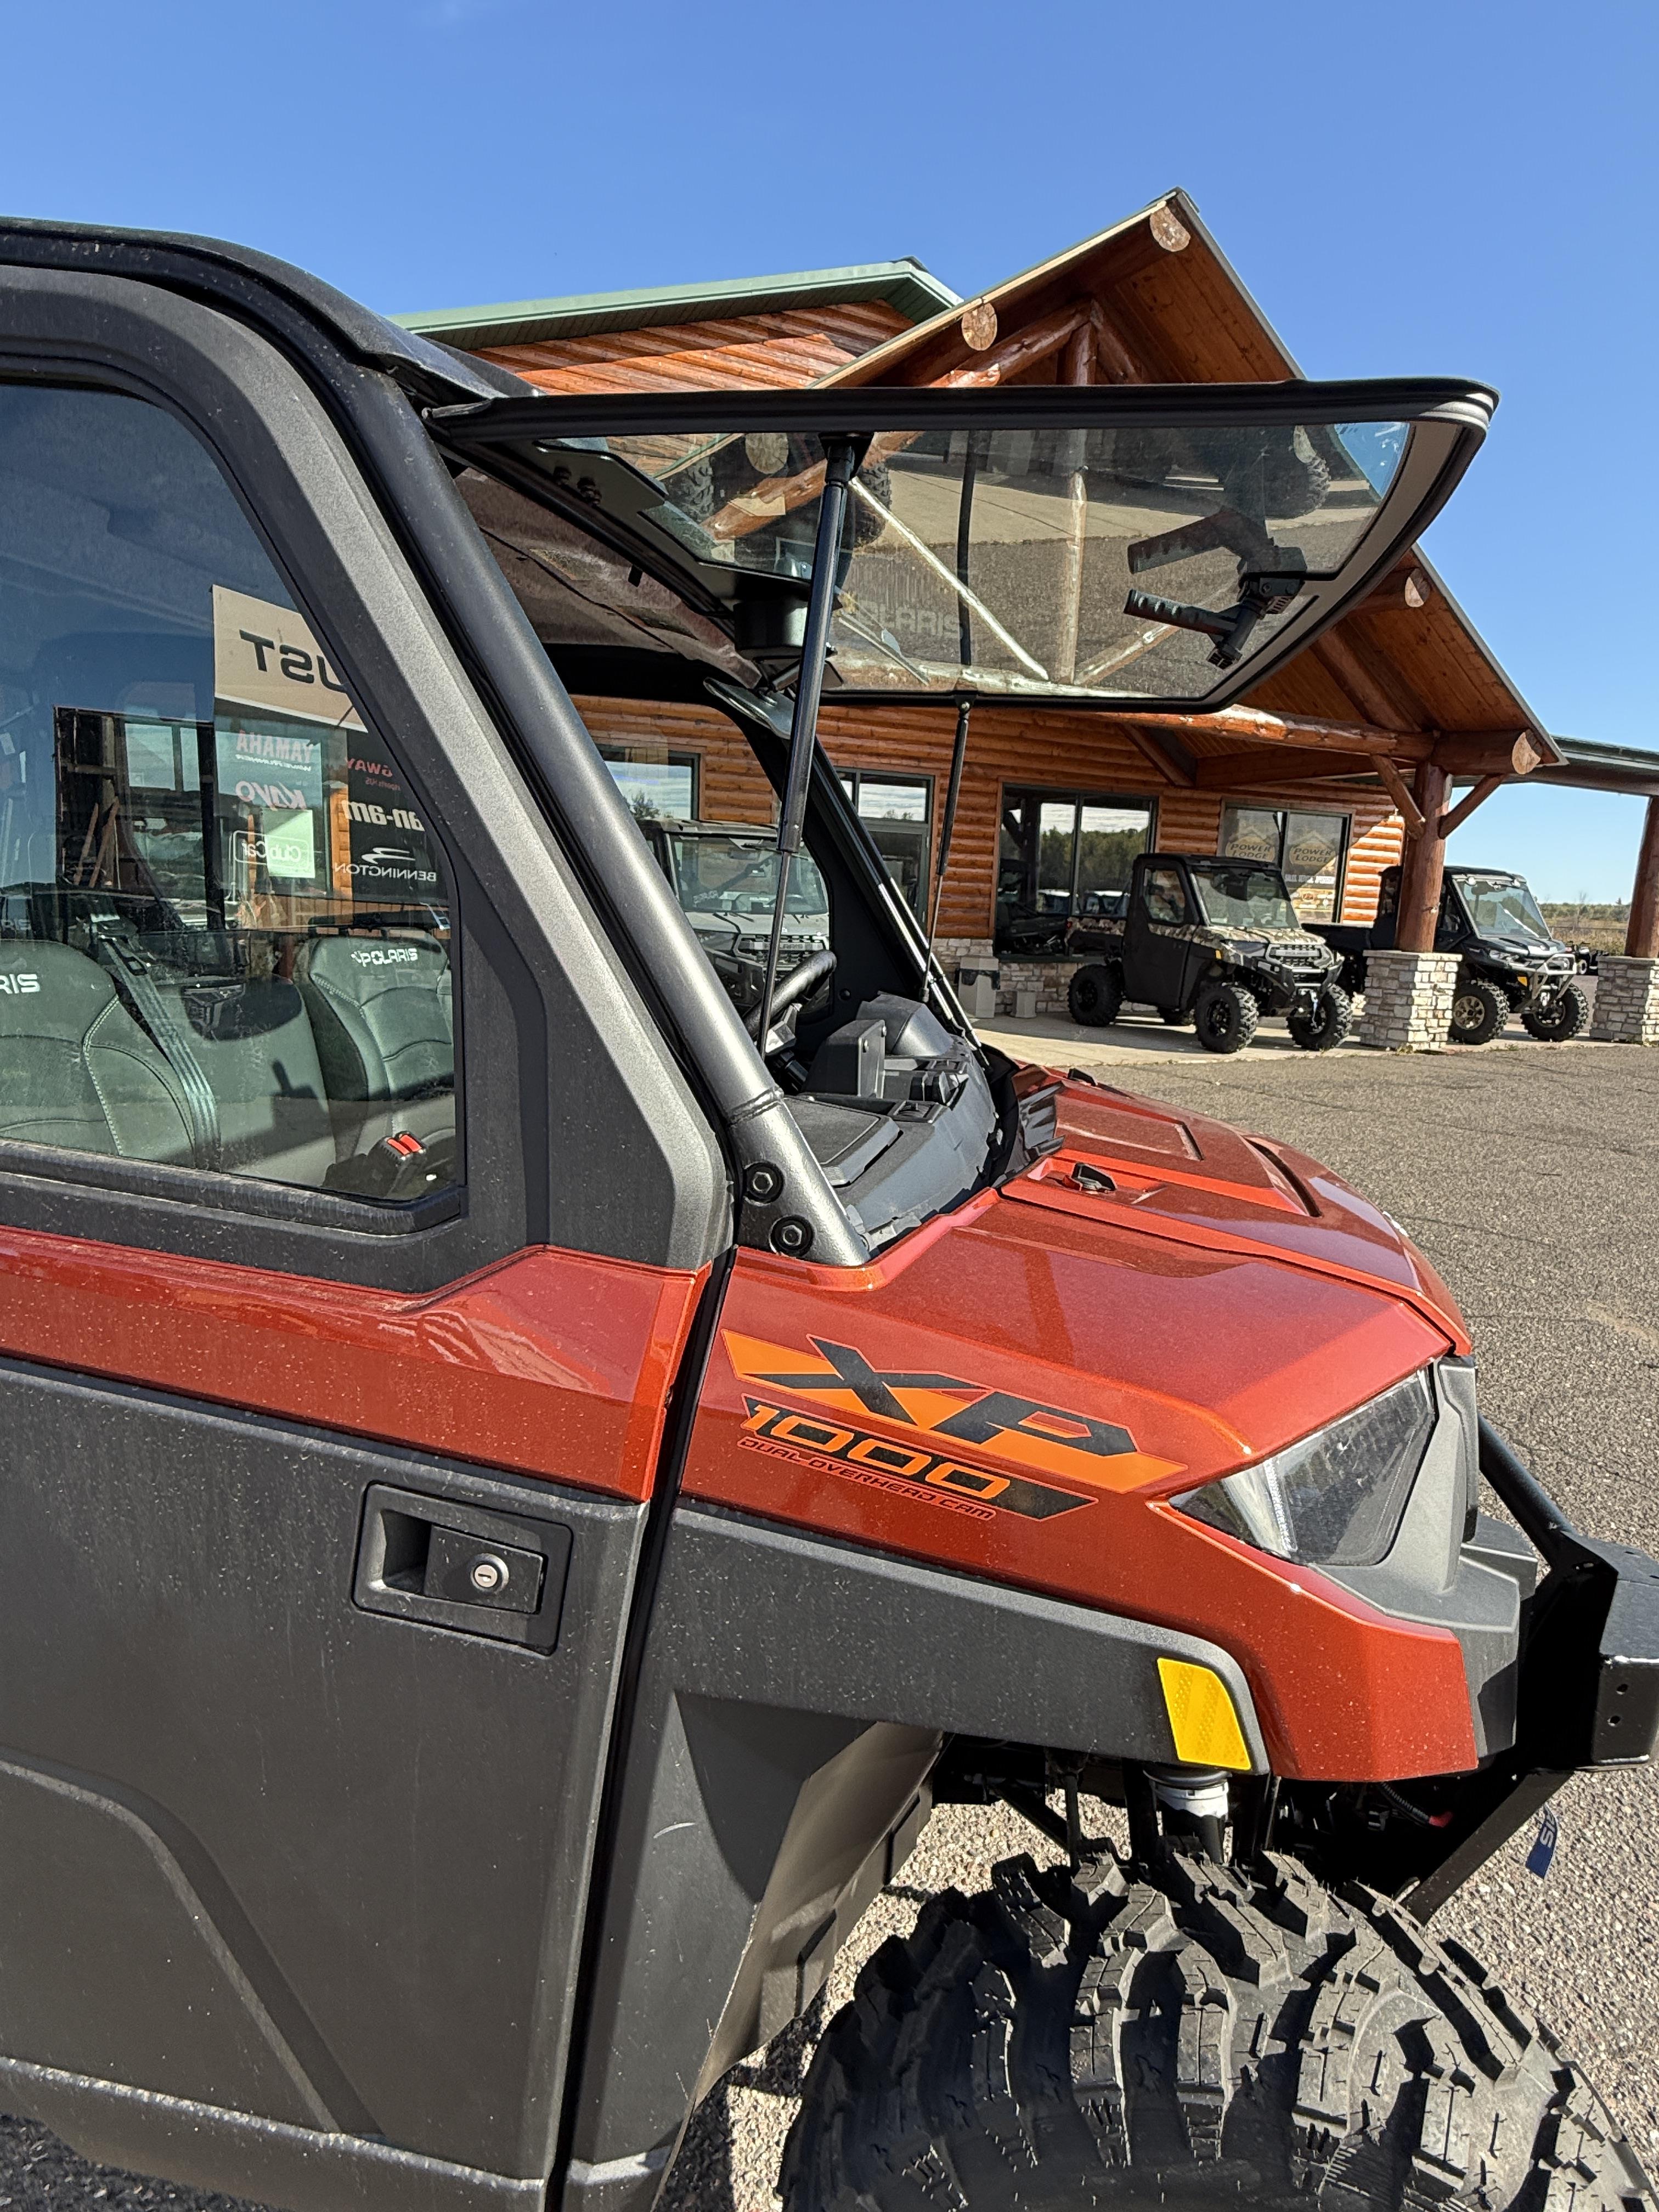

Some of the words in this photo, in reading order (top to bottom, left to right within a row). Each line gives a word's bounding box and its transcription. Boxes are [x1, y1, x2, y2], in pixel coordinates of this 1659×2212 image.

[1231, 843, 1271, 853] POWER
[1293, 848, 1333, 856] POWER
[1232, 851, 1269, 860] LODGE
[1295, 854, 1330, 864] LODGE
[359, 948, 419, 967] POLARIS
[743, 1334, 1138, 1457] XP
[742, 1404, 1011, 1500] 1000
[740, 1438, 803, 1463] DUAL
[809, 1457, 936, 1501] OVERHEAD
[939, 1498, 995, 1520] CAM
